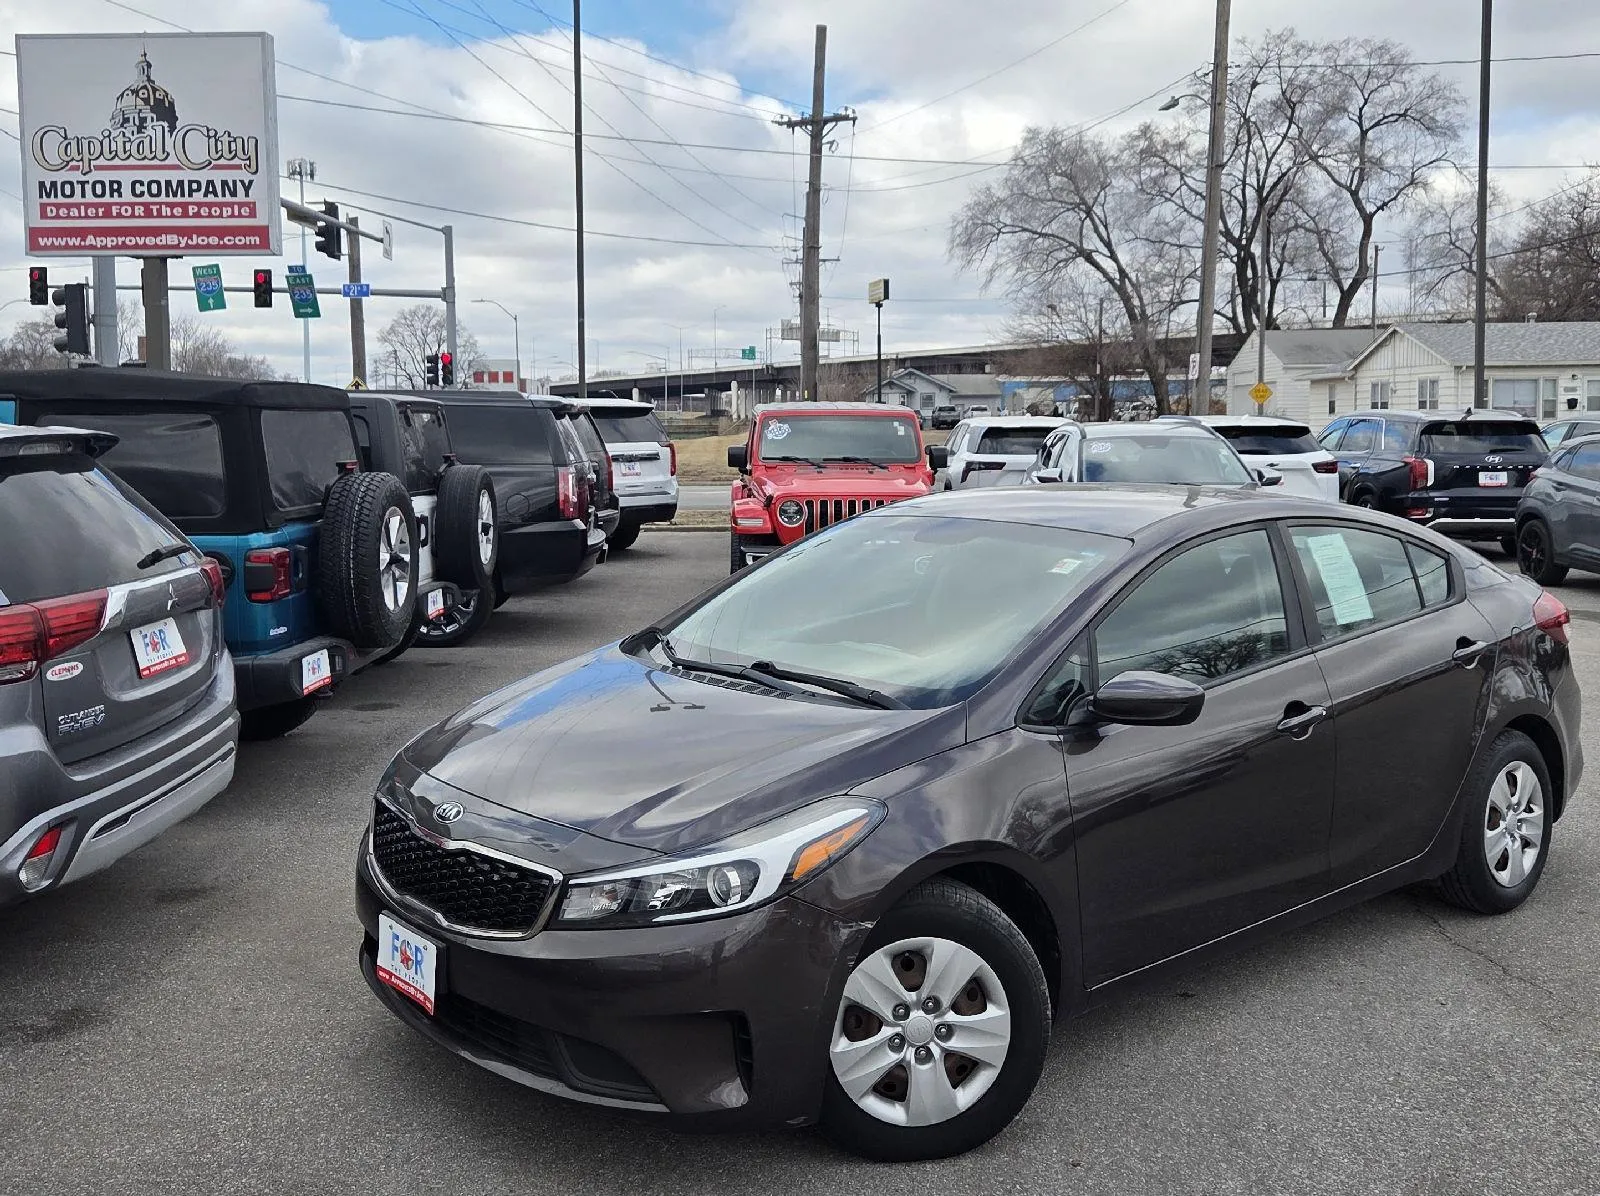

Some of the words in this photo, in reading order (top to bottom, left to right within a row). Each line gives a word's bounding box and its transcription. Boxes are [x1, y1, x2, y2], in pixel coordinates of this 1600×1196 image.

[32, 122, 171, 176] Capital
[173, 123, 258, 176] City
[38, 179, 122, 199] MOTOR
[131, 179, 254, 198] COMPANY
[46, 205, 105, 217] Dealer
[111, 205, 145, 217] FOR
[150, 204, 182, 217] The
[189, 204, 250, 218] People
[38, 233, 260, 248] www.ApprovedByJoe.com
[195, 266, 218, 276] WEST
[199, 281, 219, 292] 235
[288, 276, 310, 285] EAST
[293, 289, 313, 300] 235
[391, 932, 424, 979] FOR
